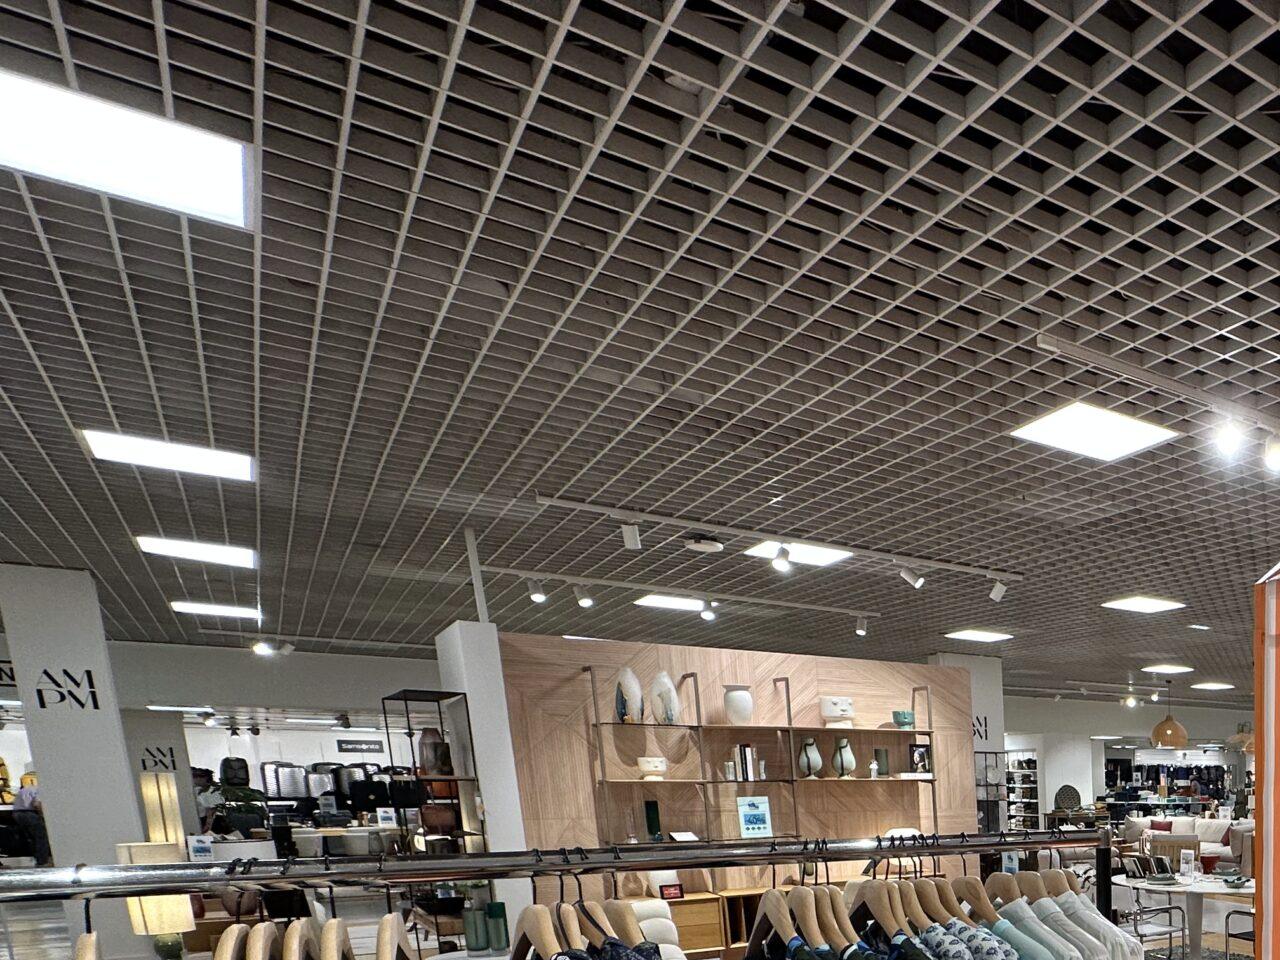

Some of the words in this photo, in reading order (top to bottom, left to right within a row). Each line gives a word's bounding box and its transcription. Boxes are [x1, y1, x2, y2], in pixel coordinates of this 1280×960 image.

[36, 669, 95, 689] AM
[36, 688, 100, 710] PM
[142, 746, 175, 759] AM
[141, 758, 177, 771] PM
